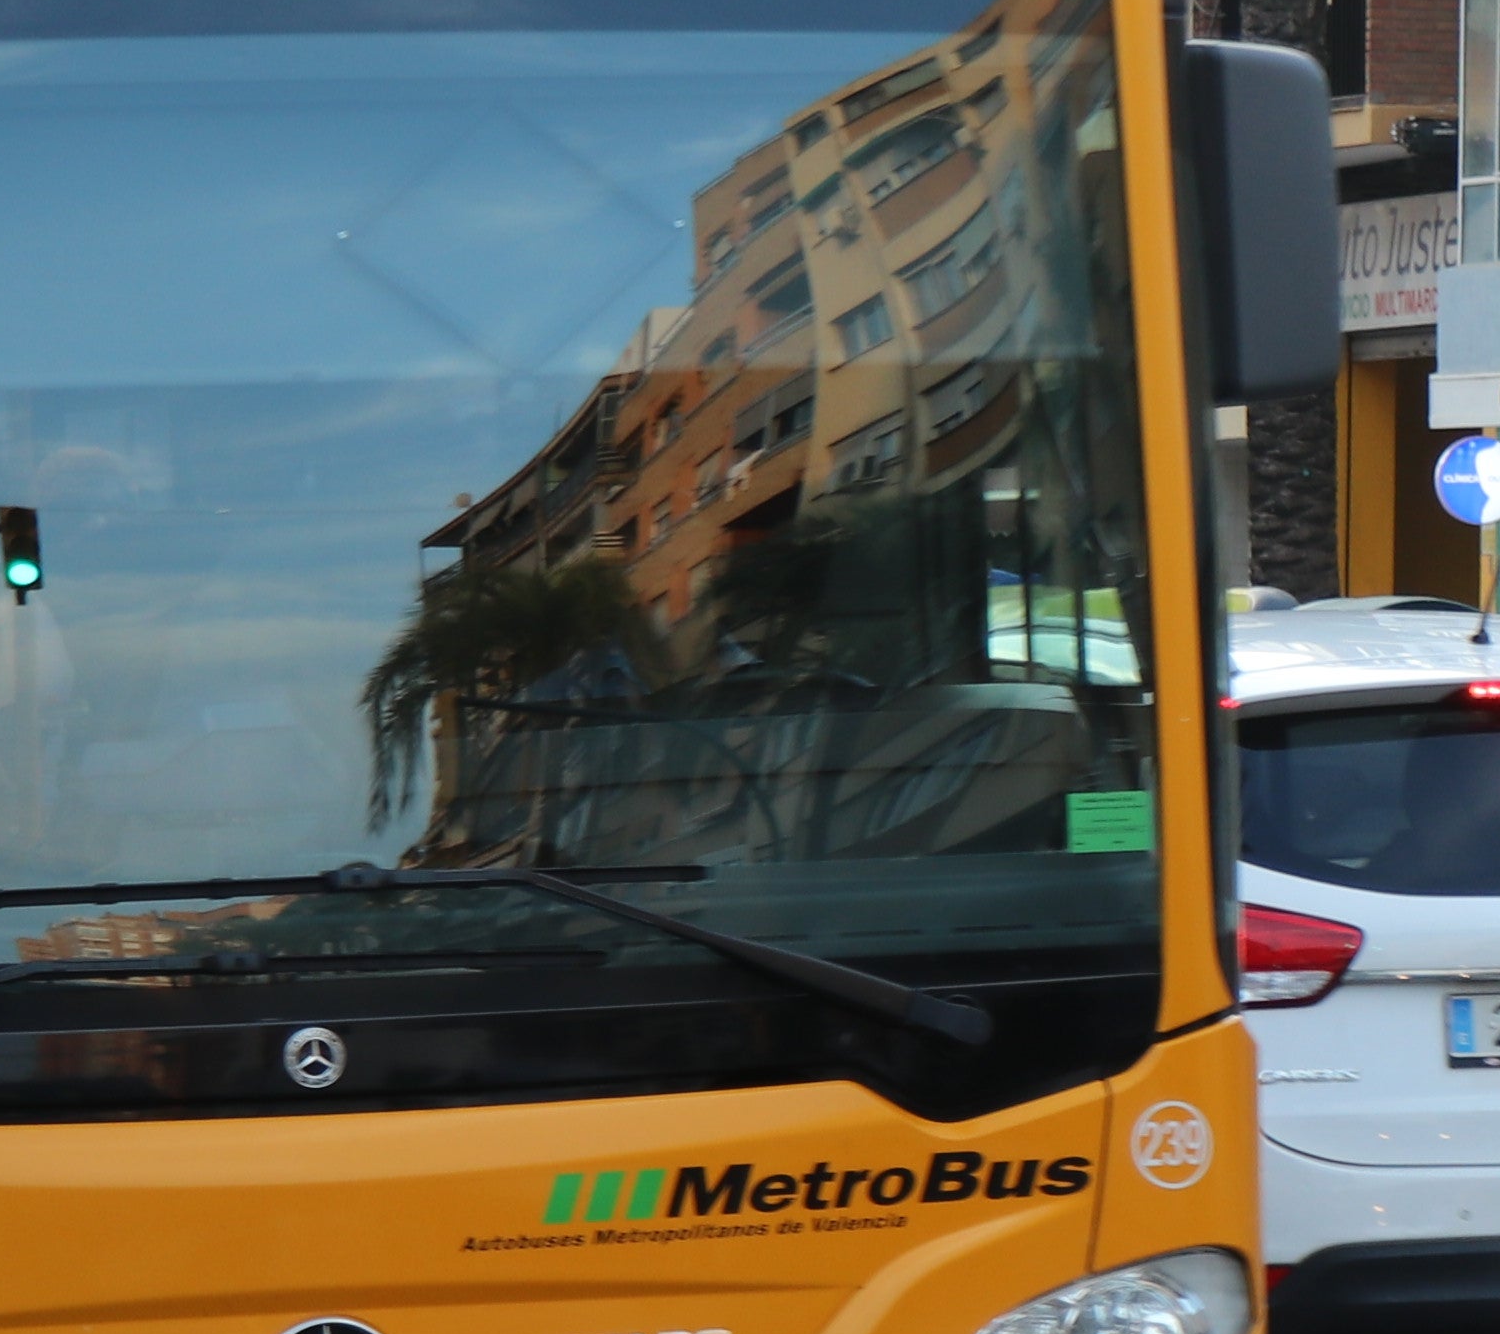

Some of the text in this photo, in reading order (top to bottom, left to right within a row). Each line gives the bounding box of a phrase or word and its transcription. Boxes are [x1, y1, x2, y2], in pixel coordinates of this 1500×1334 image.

[1138, 1120, 1204, 1168] 239
[667, 1151, 1092, 1218] MetroBus
[461, 1213, 908, 1252] Autobuses Metropolitanos de Valencia
